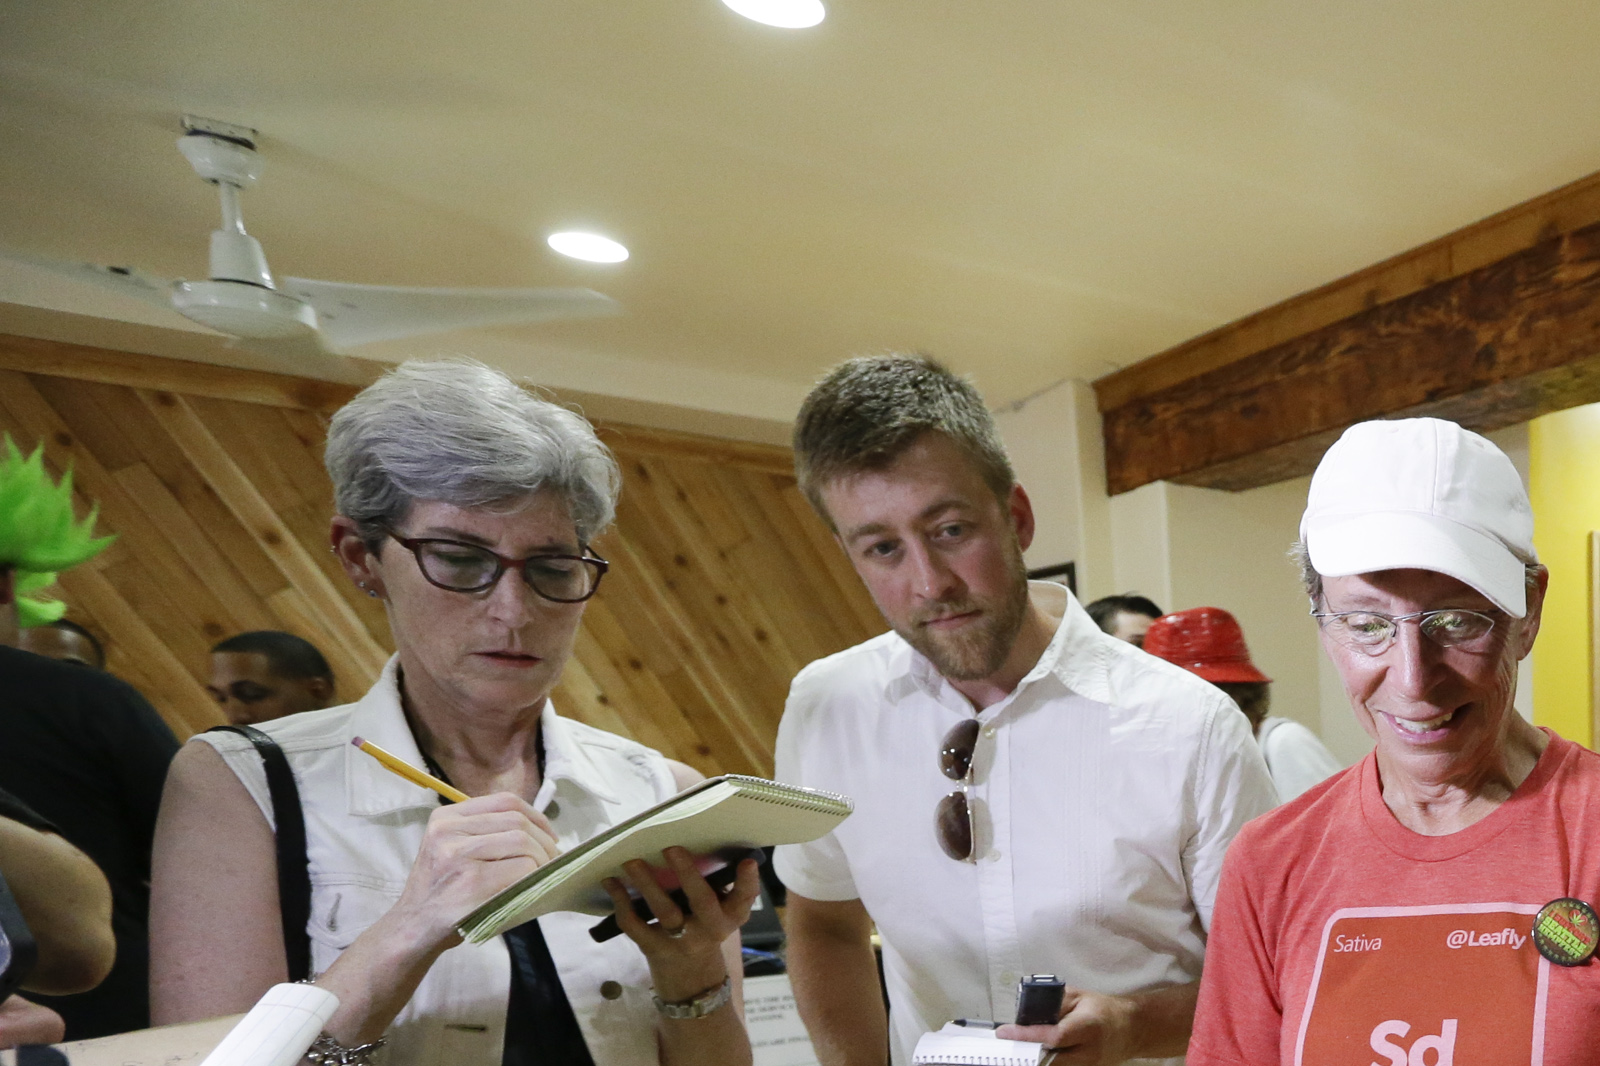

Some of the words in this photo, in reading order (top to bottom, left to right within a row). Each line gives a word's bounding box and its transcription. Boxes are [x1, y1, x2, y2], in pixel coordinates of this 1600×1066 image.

[1333, 934, 1382, 952] Sativa
[1446, 928, 1526, 949] @Leafly
[1538, 923, 1582, 959] HEMPFEST
[1542, 916, 1587, 954] SEATTLE
